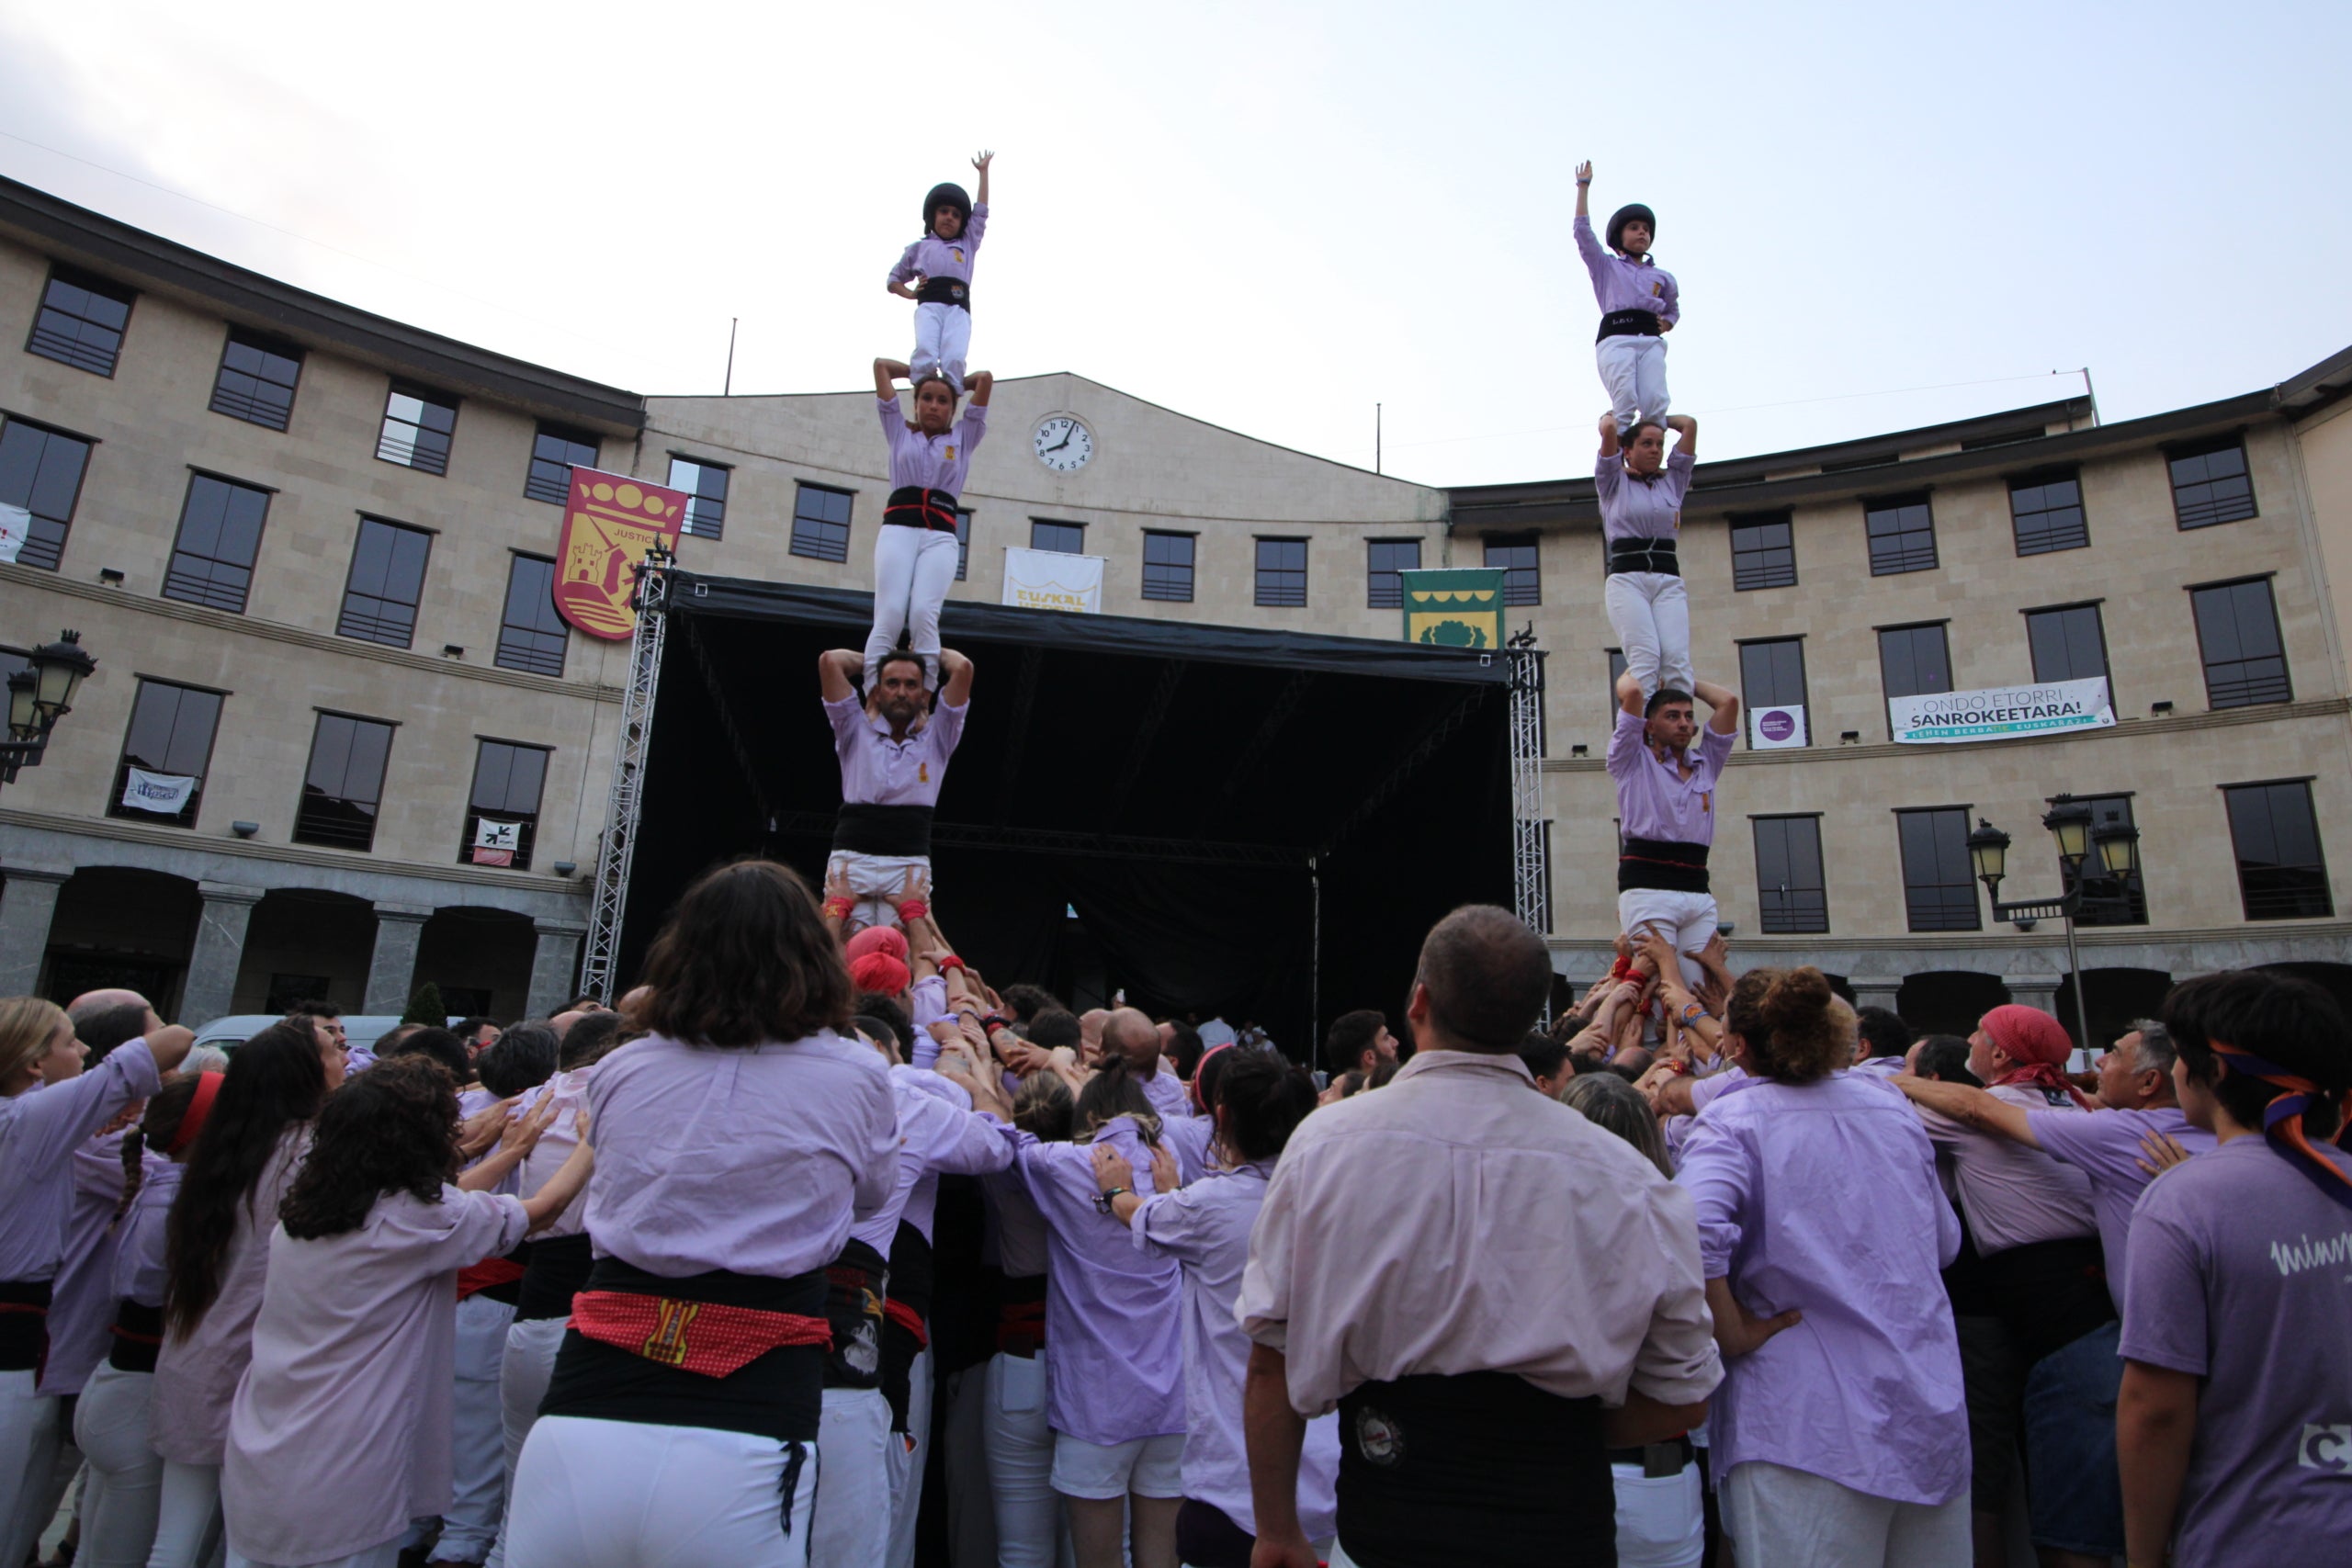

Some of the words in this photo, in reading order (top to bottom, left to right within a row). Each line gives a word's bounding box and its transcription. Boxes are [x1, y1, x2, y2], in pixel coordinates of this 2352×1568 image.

[1075, 425, 1080, 434] 1
[614, 528, 656, 545] JUSTIC
[1016, 590, 1086, 606] EUSKAL
[1924, 695, 1985, 713] ONDO
[1993, 688, 2063, 708] ETORRI
[1911, 701, 2082, 728] SANROKEETARA!
[1912, 728, 1950, 739] LEHEN
